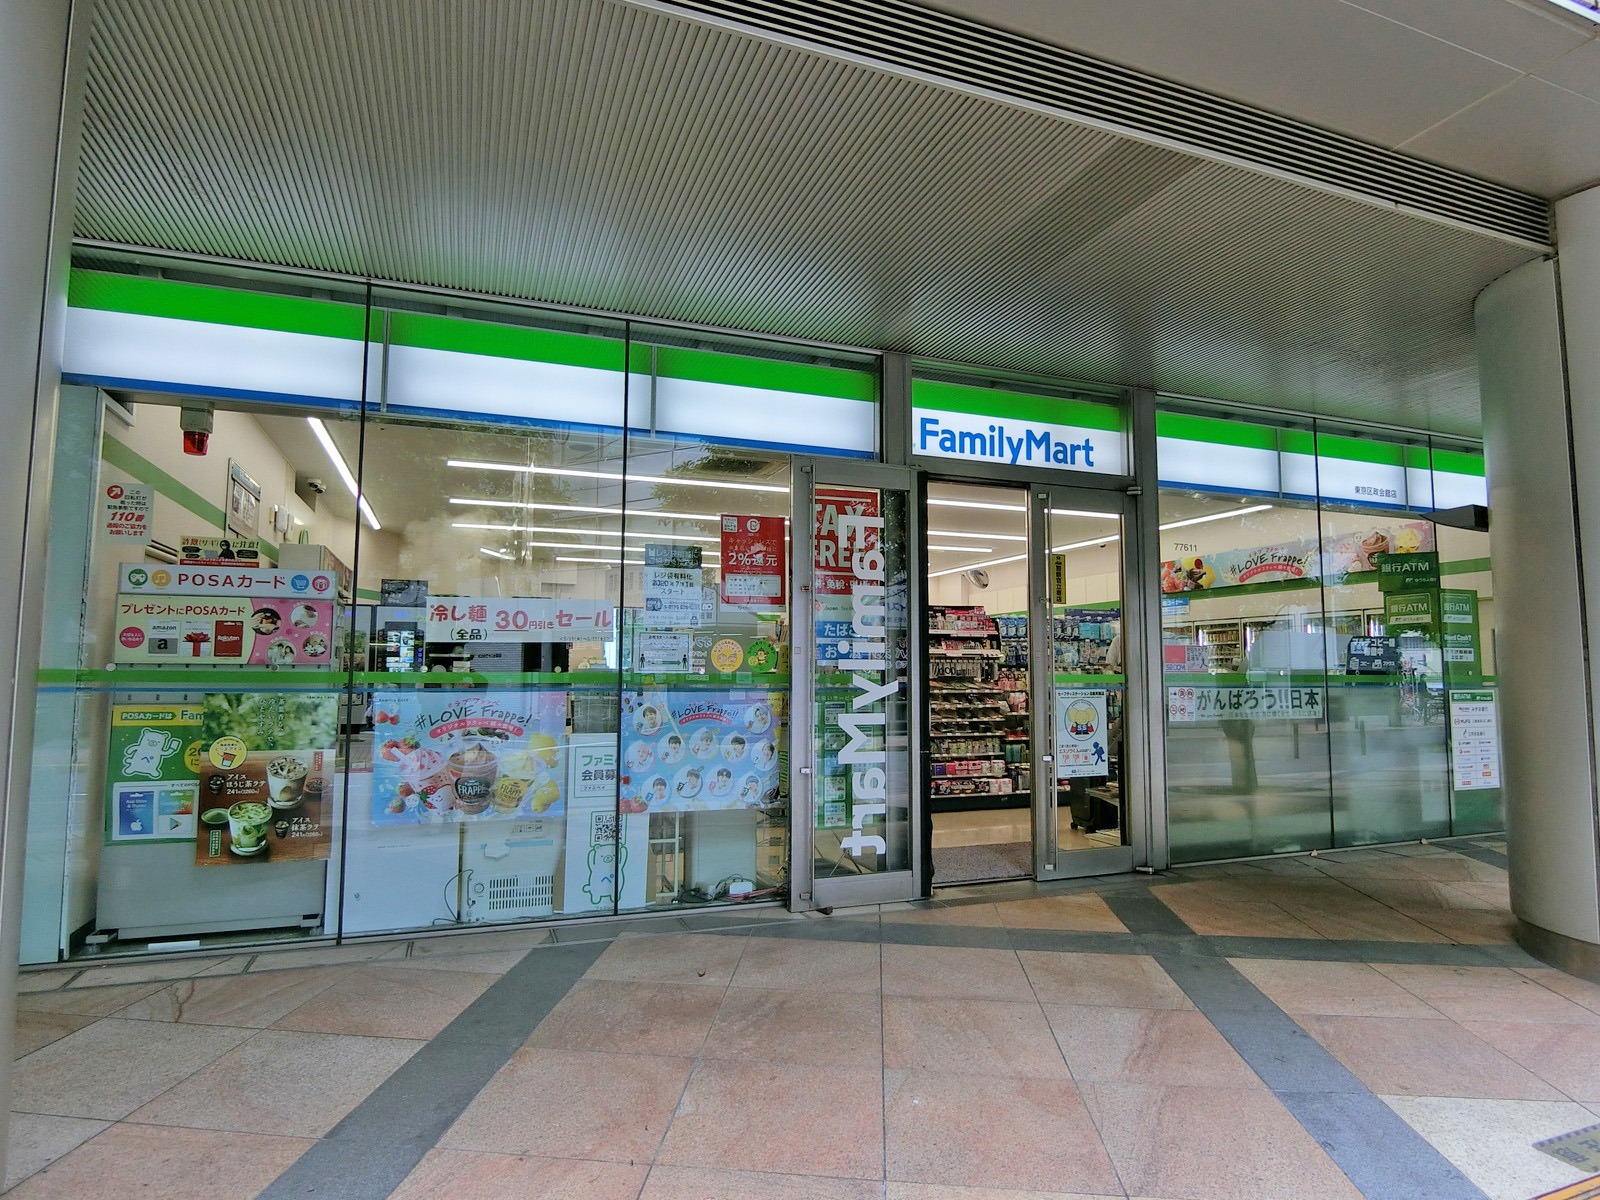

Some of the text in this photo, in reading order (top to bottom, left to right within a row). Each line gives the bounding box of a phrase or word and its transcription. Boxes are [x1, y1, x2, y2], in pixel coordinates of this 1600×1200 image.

[920, 417, 1094, 467] FamilyMart
[1354, 485, 1397, 498] 東京区政会館店
[815, 539, 865, 568] RE
[1174, 543, 1198, 552] 77611
[1230, 553, 1309, 576] #LOVE Frappe!
[1381, 562, 1429, 573] 銀行ATM
[178, 574, 286, 589] POSAカード
[121, 603, 245, 616] プレゼントにPOSAカード
[1390, 603, 1427, 613] 銀行ATM
[430, 604, 612, 630] 冷し麺 30円引き セール
[217, 634, 240, 642] Rakuten
[450, 628, 488, 641] (全品)
[1165, 663, 1186, 671] SECOM
[1197, 688, 1319, 711] がんばろう!!日本
[415, 704, 533, 729] #LOVE Frappe!
[671, 704, 704, 720] #LOVE
[582, 754, 615, 767] ファミ
